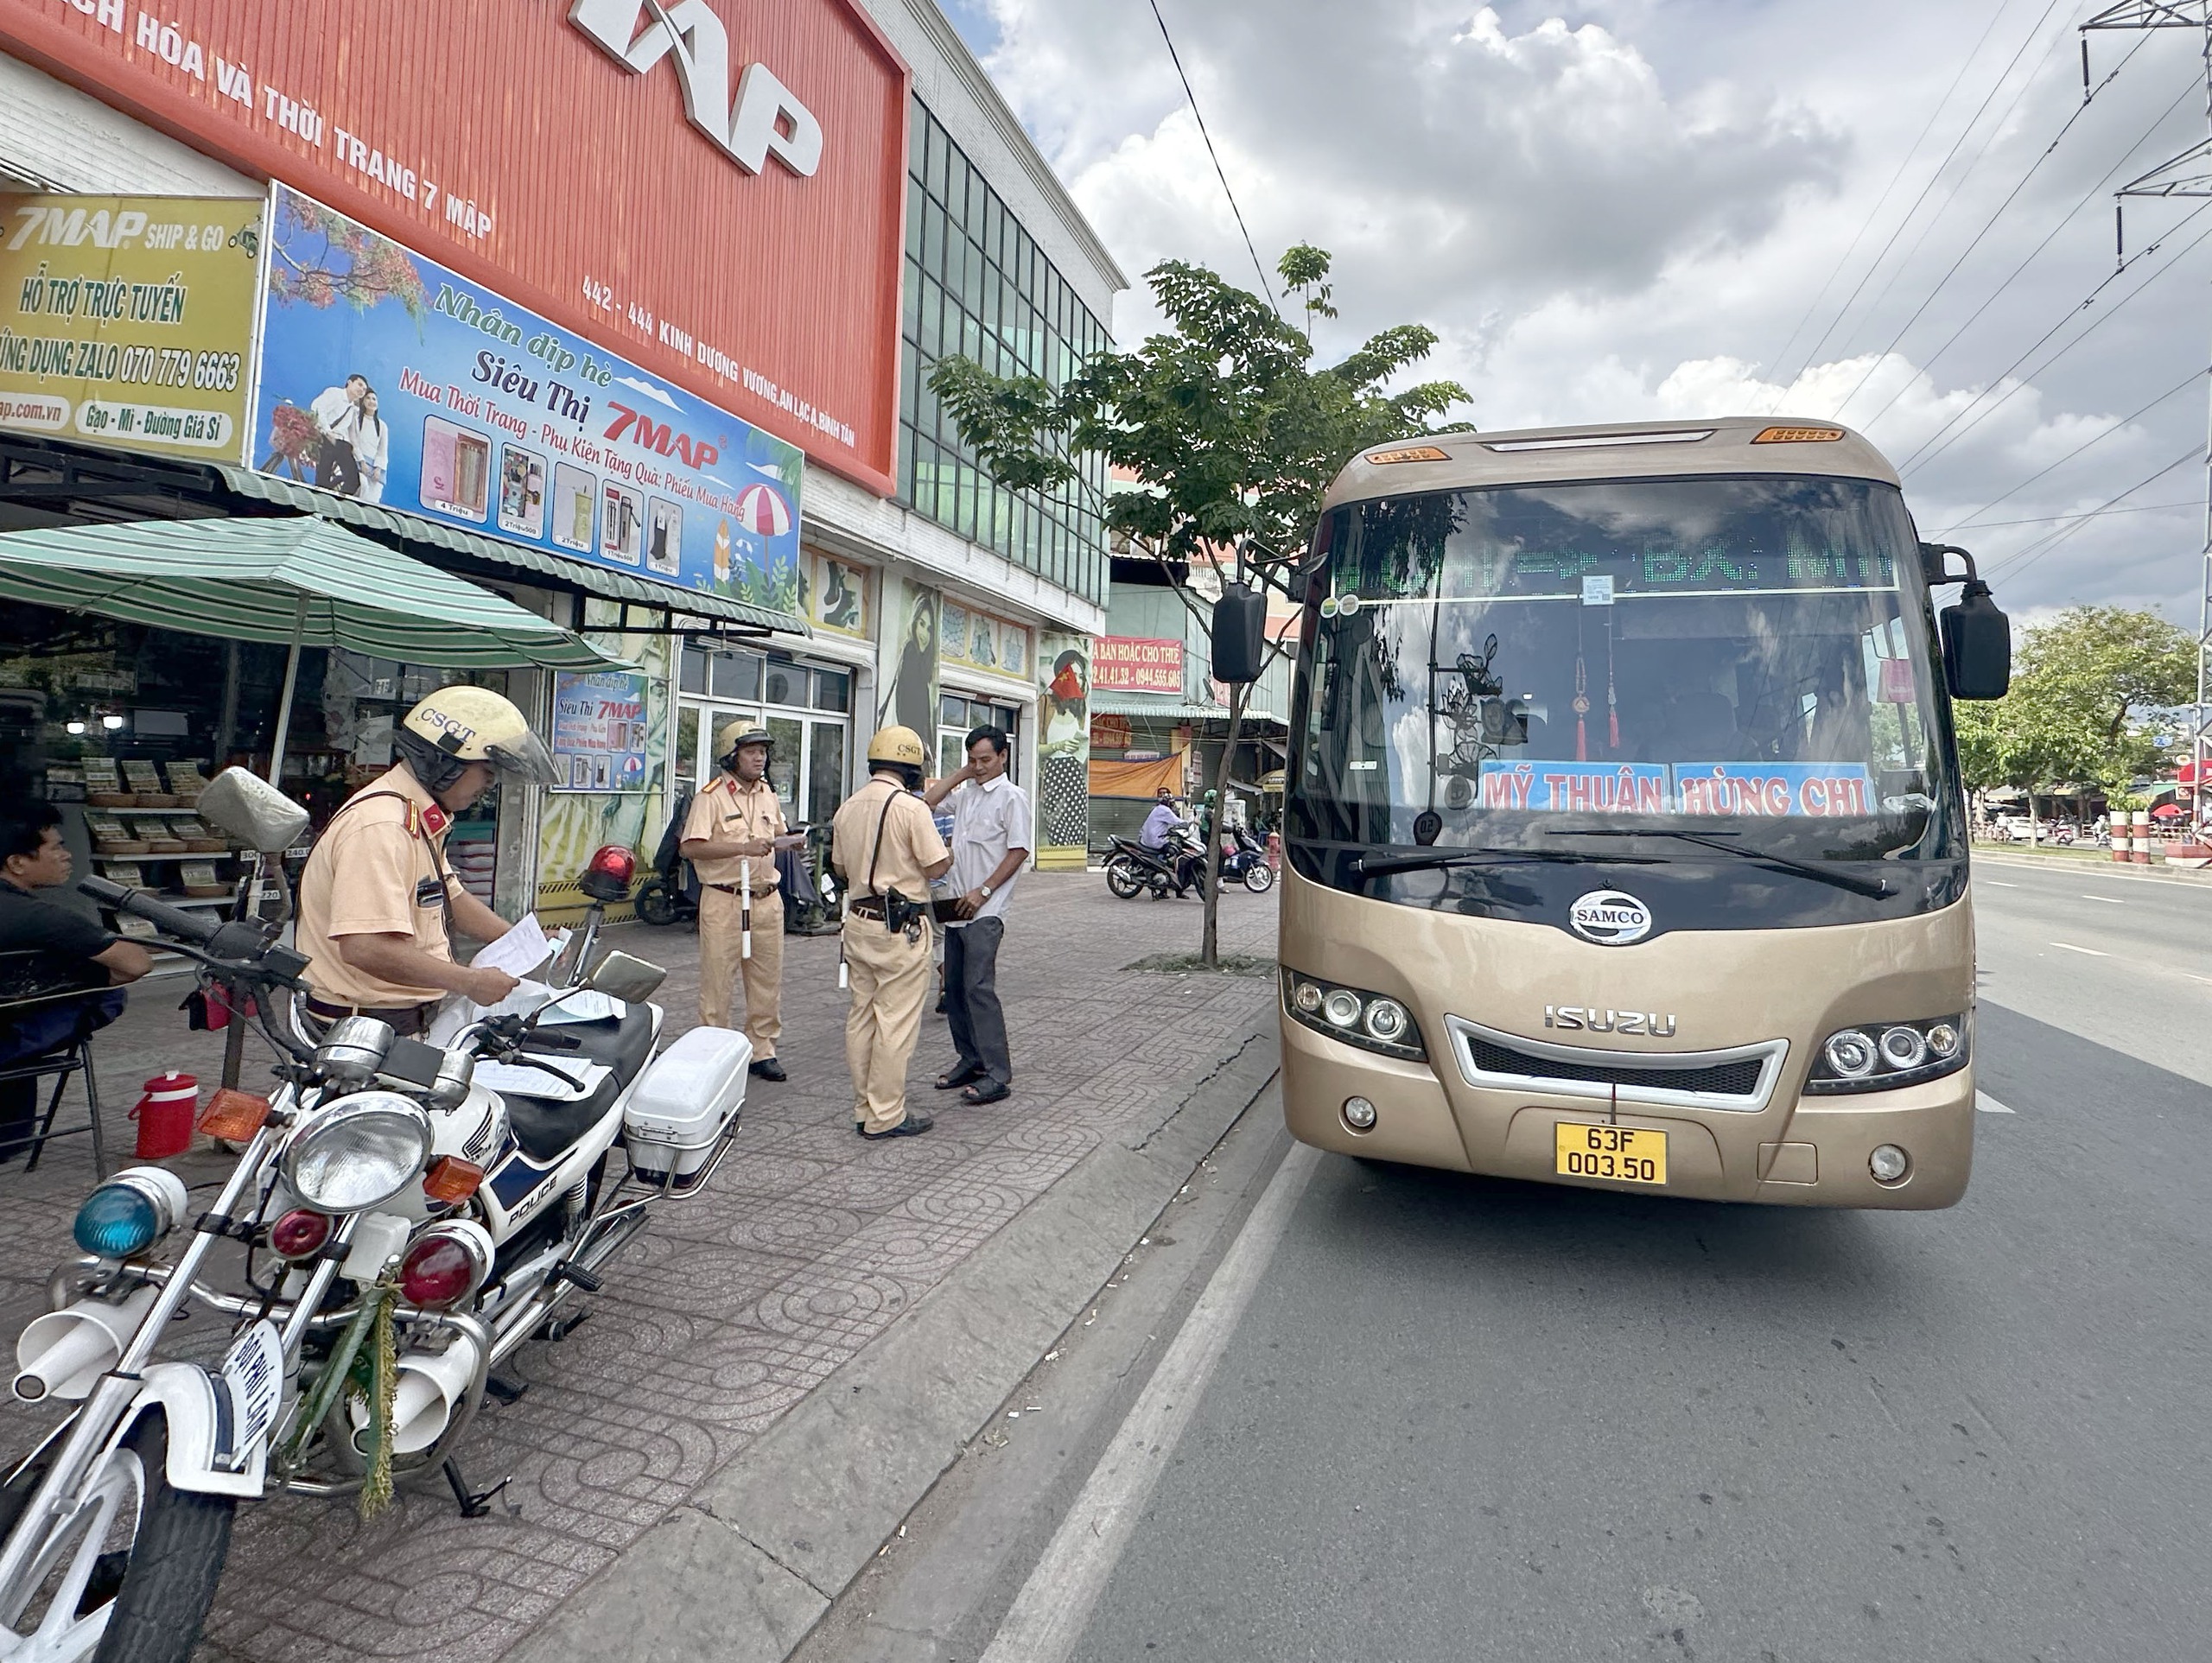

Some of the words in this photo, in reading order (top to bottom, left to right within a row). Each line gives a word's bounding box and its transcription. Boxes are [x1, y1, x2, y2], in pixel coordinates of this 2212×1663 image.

[136, 10, 205, 82] HÓA
[215, 55, 253, 110] VÀ
[264, 85, 323, 148] THỜI
[334, 126, 416, 201] TRANG
[423, 179, 438, 210] 7
[445, 193, 492, 240] MẬP
[7, 206, 148, 251] 7MAP
[144, 224, 182, 250] SHIP
[184, 225, 199, 250] &
[200, 225, 225, 251] GO
[20, 261, 48, 313] HỖ
[48, 273, 83, 324] TRỢ
[83, 276, 127, 327] TRỰC
[129, 271, 187, 324] TUYẾN
[434, 282, 523, 347] Nhân
[527, 333, 575, 372] dịp
[580, 353, 613, 388] hè
[581, 275, 612, 312] 442
[627, 301, 653, 336] 444
[658, 319, 692, 358] KINH
[697, 340, 739, 383] DƯƠNG
[28, 338, 75, 384] DỤNG
[74, 342, 118, 381] ZALO
[120, 345, 155, 384] 070
[156, 347, 192, 388] 779
[193, 351, 241, 392] 6663
[86, 405, 109, 433] Gạo
[118, 409, 135, 431] Mì
[143, 410, 182, 440] Đường
[184, 412, 205, 439] Giá
[471, 350, 539, 404] Siêu
[546, 380, 592, 433] Thị
[603, 401, 720, 471] 7MAP
[398, 367, 442, 403] Mua
[447, 385, 481, 418] Thời
[484, 401, 528, 441] Trang
[541, 423, 569, 455] Phụ
[571, 437, 601, 466] Kiện
[605, 448, 631, 479] Tặng
[664, 473, 694, 500] Phiếu
[696, 487, 720, 510] Mua
[720, 498, 746, 522] Hàng
[441, 501, 447, 510] 4
[1141, 645, 1159, 663] CHO
[420, 708, 477, 743] CSGT
[559, 698, 577, 715] Siêu
[597, 701, 642, 720] 7MAP
[1484, 764, 1535, 810] MỸ
[1680, 766, 1790, 816] HÙNG
[1798, 778, 1871, 816] CHI
[1577, 910, 1644, 924] SAMCO
[1545, 1005, 1675, 1038] ISUZU
[1587, 1128, 1635, 1152] 63F
[1567, 1152, 1655, 1181] 003.50
[508, 1175, 557, 1227] POLICE
